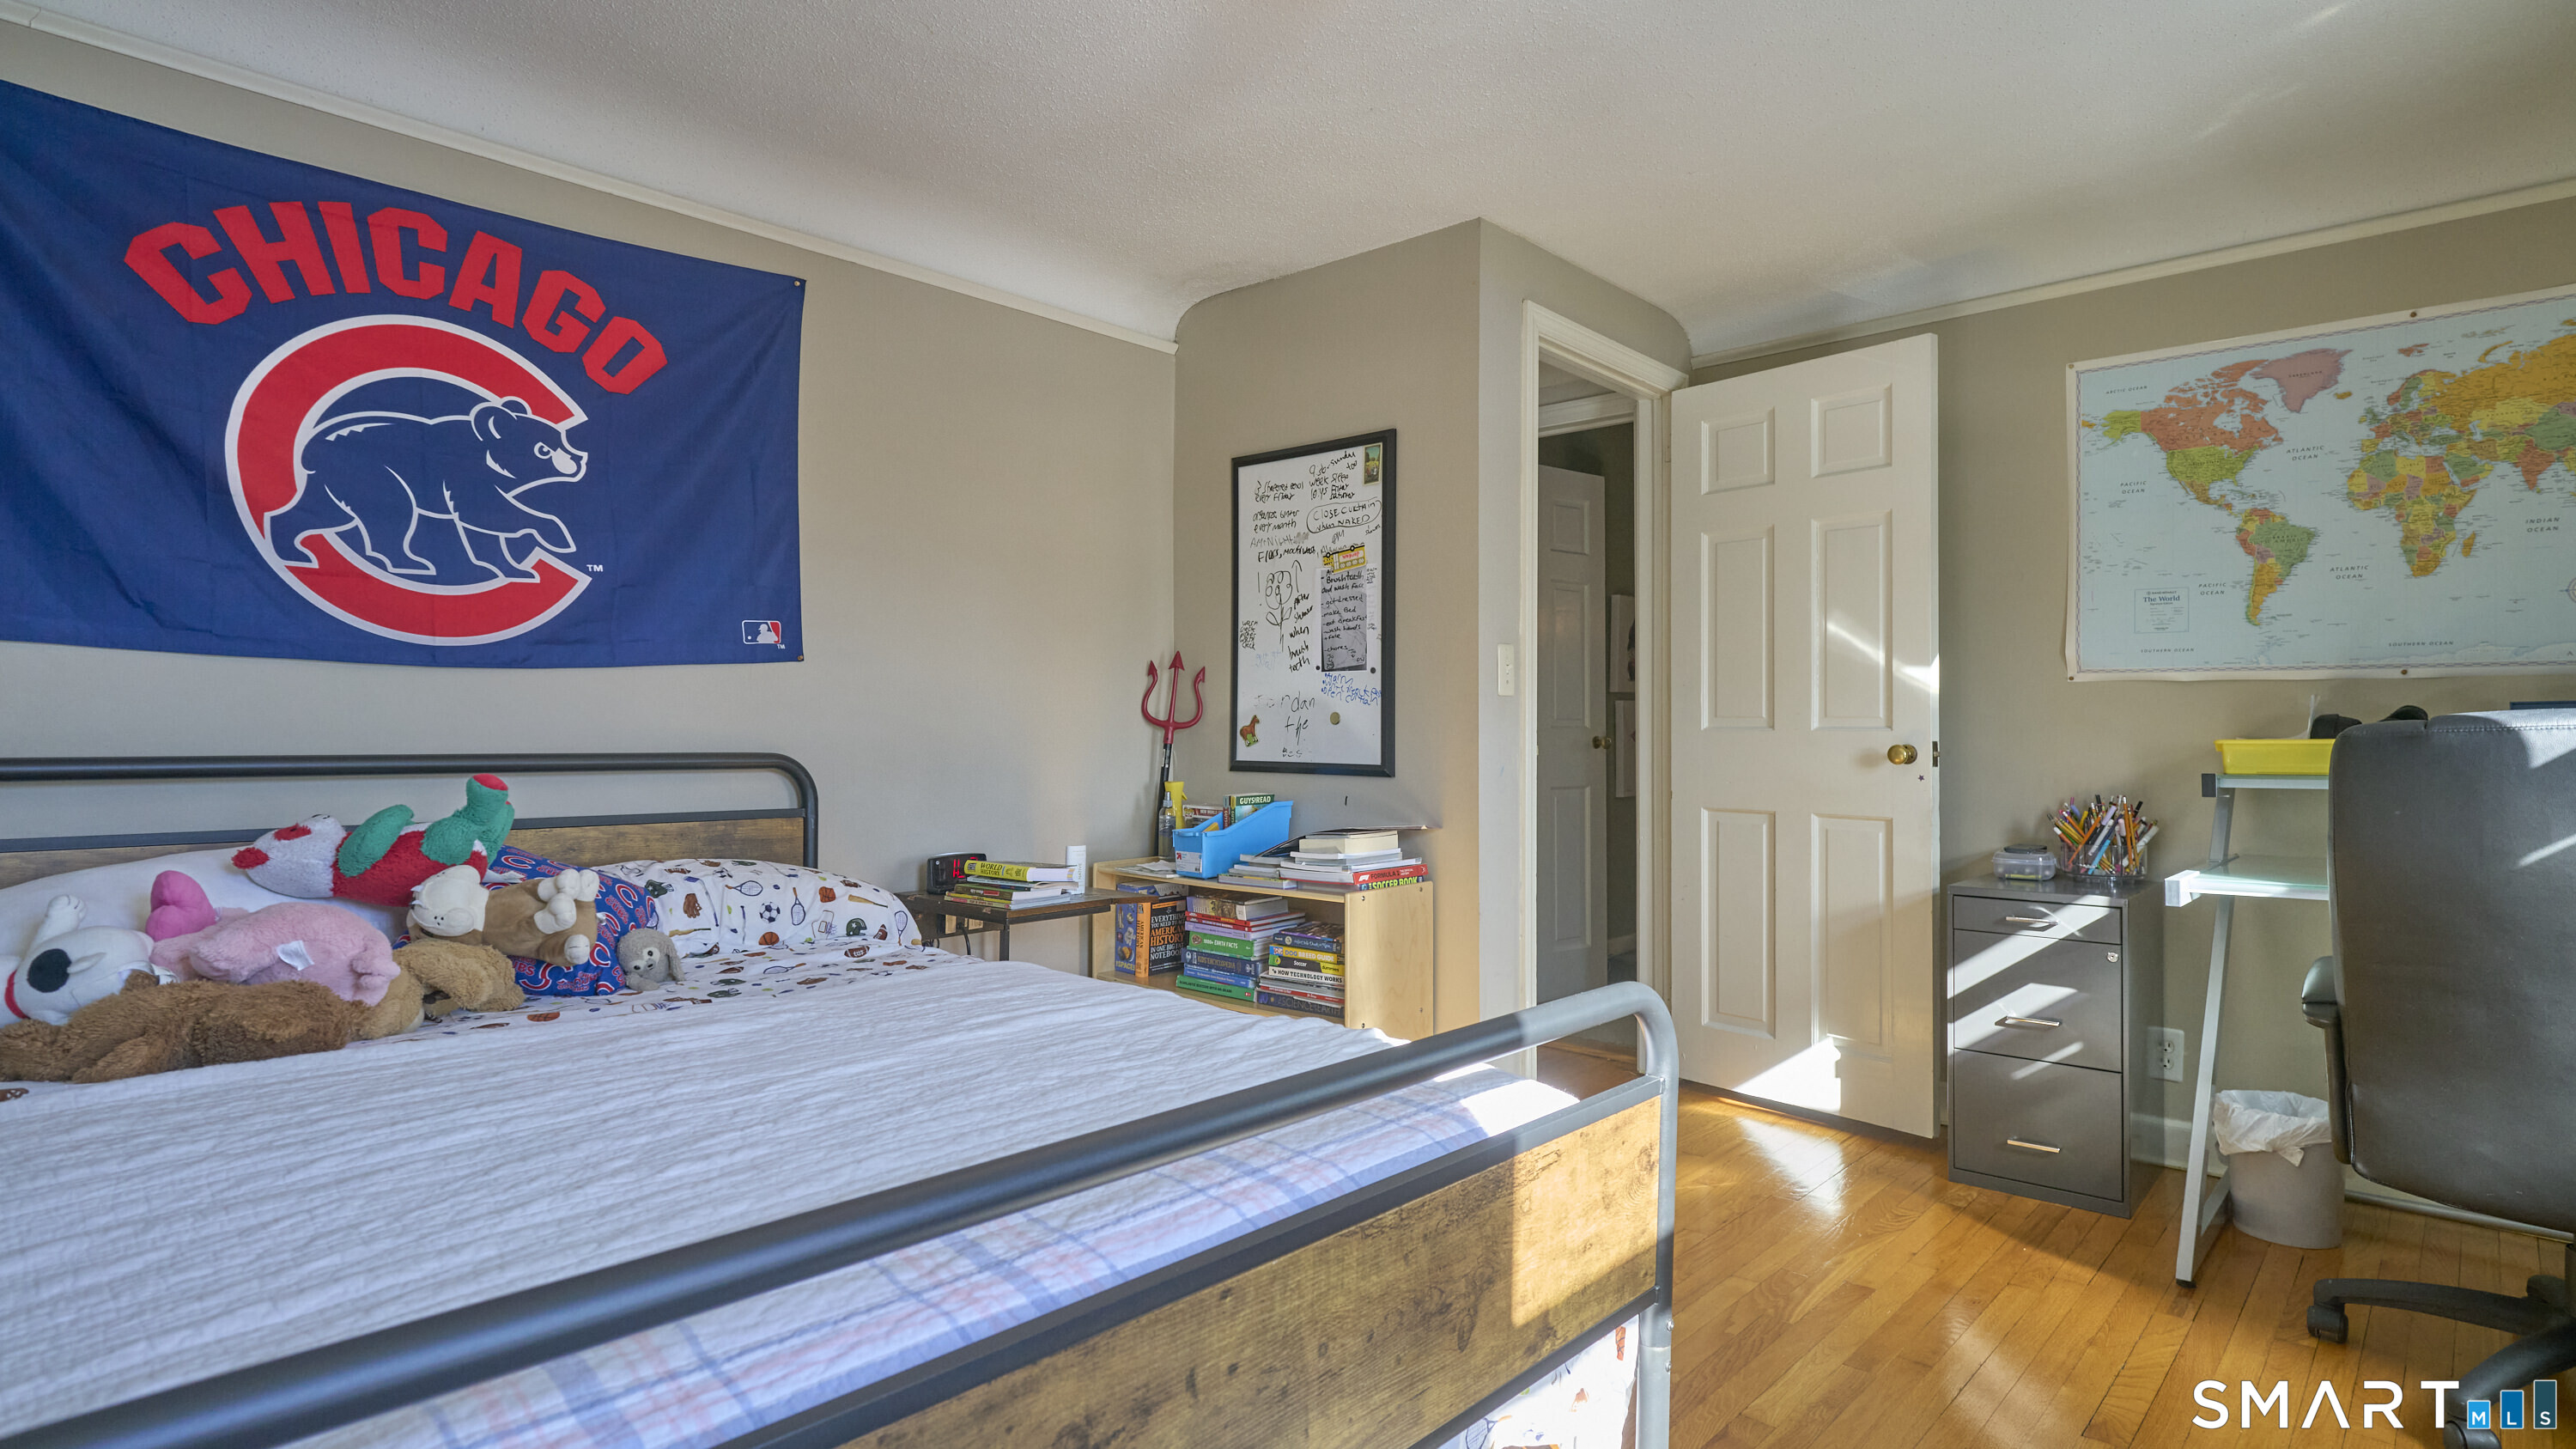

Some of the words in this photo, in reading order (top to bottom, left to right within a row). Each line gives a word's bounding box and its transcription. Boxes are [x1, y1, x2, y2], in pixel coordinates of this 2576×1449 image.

[124, 200, 668, 395] CHICAGO
[2286, 445, 2325, 454] ATLANTIC
[2330, 564, 2370, 573] ATLANTIC
[2158, 594, 2181, 602] World
[1289, 625, 1310, 639] when
[1370, 871, 1395, 880] FORMULA
[1372, 879, 1399, 890] SOCCER
[1399, 876, 1418, 886] BOOK
[1151, 925, 1185, 937] AMERICAN
[1150, 933, 1184, 947] HISTORY
[1297, 951, 1316, 959] BREED
[1316, 953, 1334, 962] GUIDE
[1290, 971, 1323, 981] TECHNOLOGY
